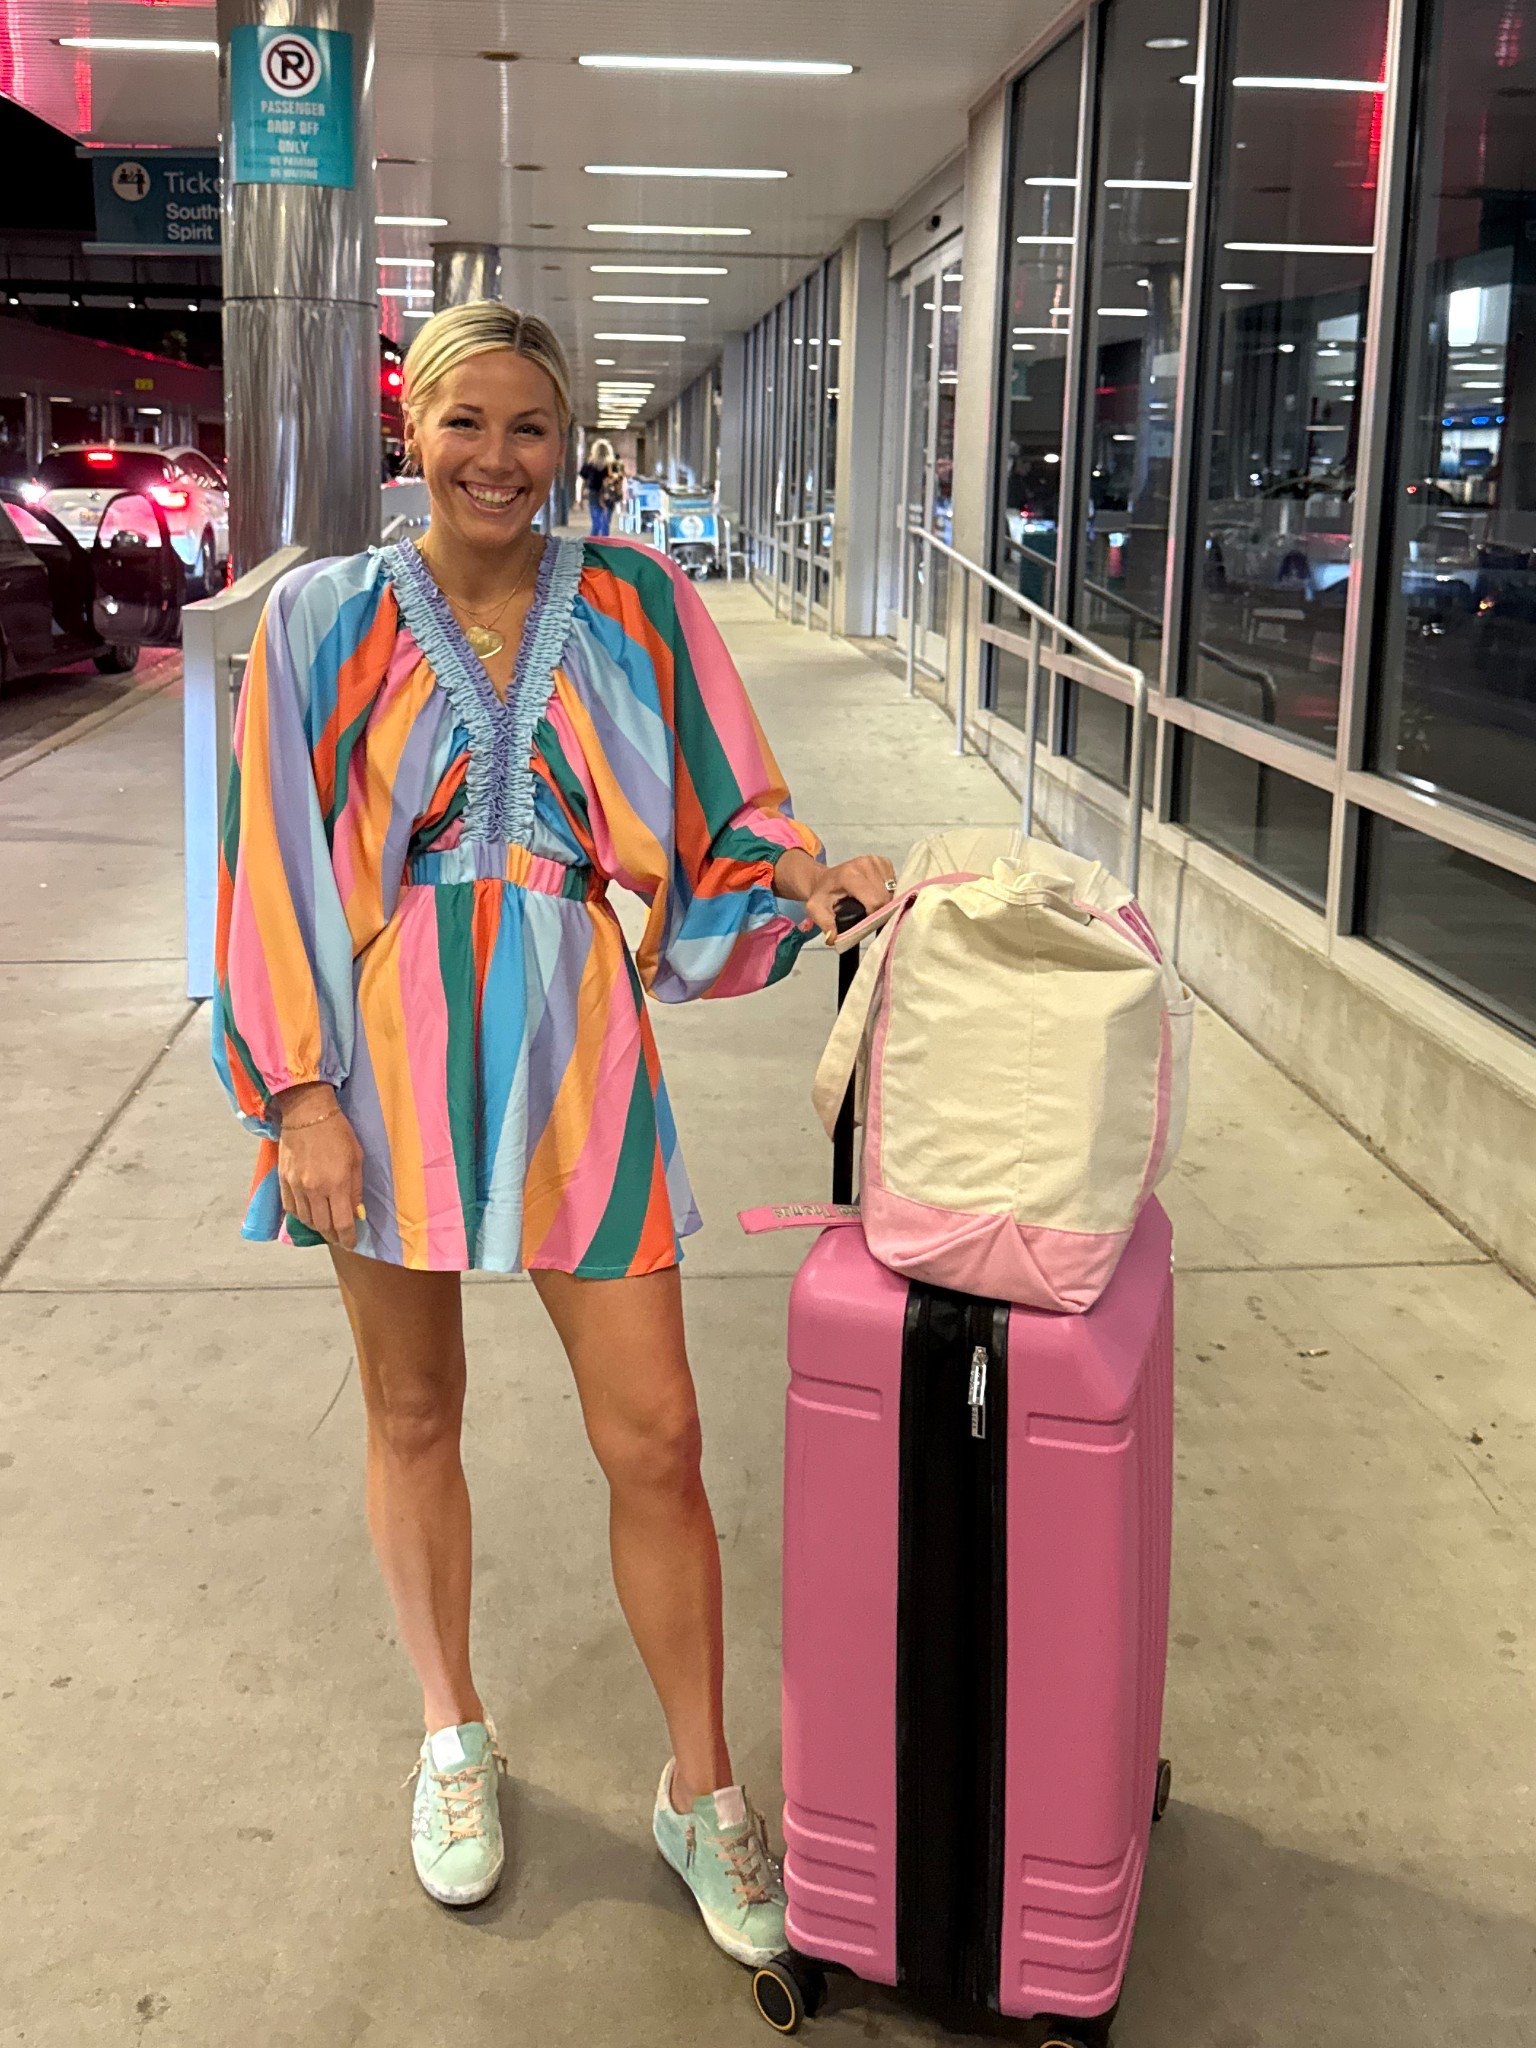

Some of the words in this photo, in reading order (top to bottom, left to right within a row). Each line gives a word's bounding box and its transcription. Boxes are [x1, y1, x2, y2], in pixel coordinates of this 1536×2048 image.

[261, 100, 325, 117] PASSENGER
[267, 120, 296, 134] DROP
[299, 121, 319, 136] OFF
[278, 139, 309, 154] ONLY
[166, 202, 219, 220] South
[168, 222, 214, 242] Spirit
